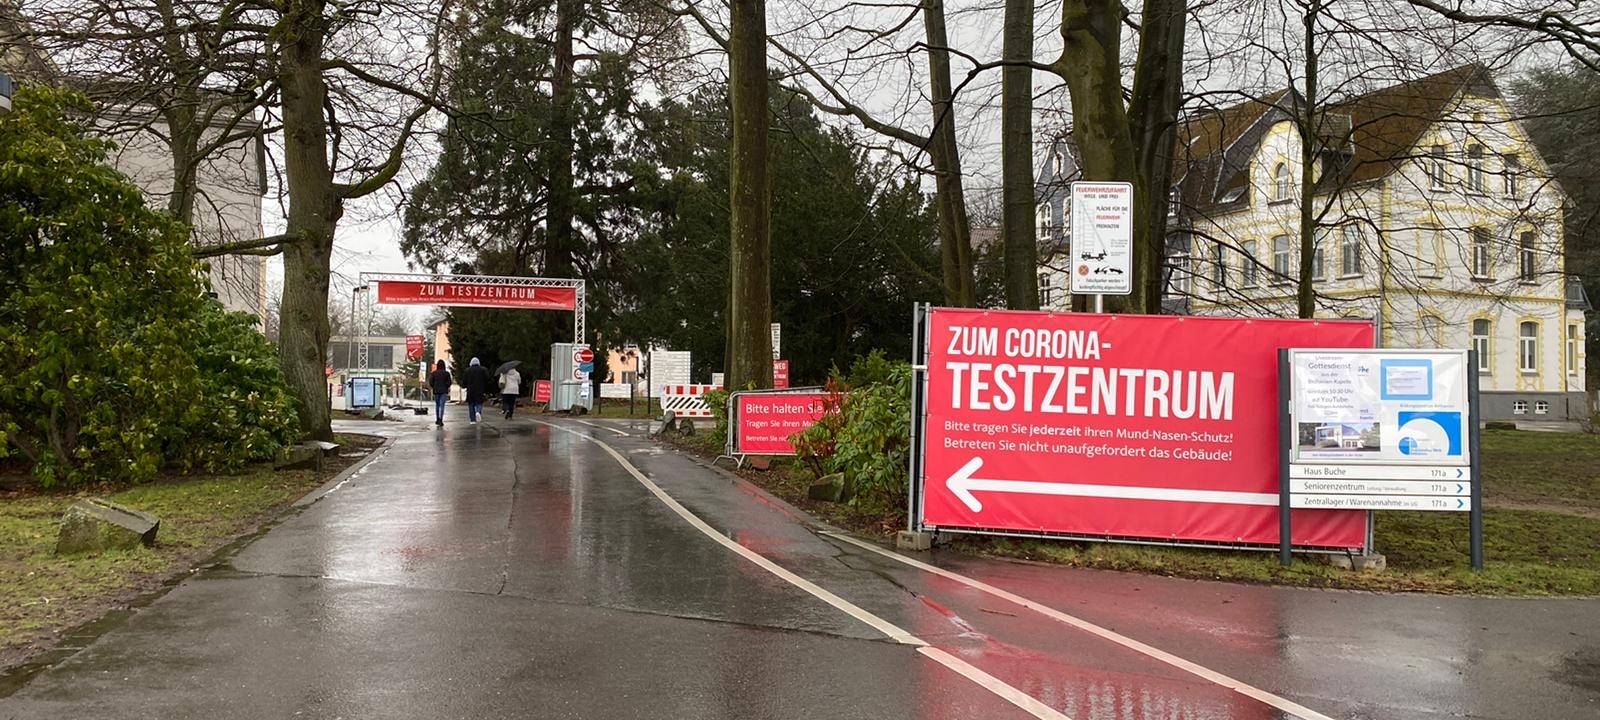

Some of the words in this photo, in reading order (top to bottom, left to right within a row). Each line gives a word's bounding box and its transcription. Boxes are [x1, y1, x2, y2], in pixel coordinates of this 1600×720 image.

[420, 284, 444, 296] ZUM
[450, 286, 535, 299] TESTZENTRUM
[947, 326, 998, 356] ZUM
[1005, 328, 1112, 360] CORONA-
[946, 362, 1234, 420] TESTZENTRUM
[745, 404, 769, 414] Bitte
[772, 404, 804, 414] halten
[746, 420, 768, 428] Tragen
[944, 421, 970, 431] Bitte
[973, 423, 1008, 436] tragen
[1011, 424, 1027, 433] Sie
[1030, 424, 1081, 437] jederzeit
[1084, 426, 1113, 437] ihren
[1116, 428, 1233, 443] Mund-Nasen-Schutz!
[944, 438, 996, 449] Betreten
[999, 440, 1016, 450] Sie
[1019, 441, 1048, 452] nicht
[1052, 443, 1145, 458] unaufgefordert
[1149, 447, 1170, 458] das
[1173, 448, 1232, 461] Gebäude!
[1304, 482, 1365, 490] Seniorenzentrum
[1304, 498, 1344, 508] Zentrallager
